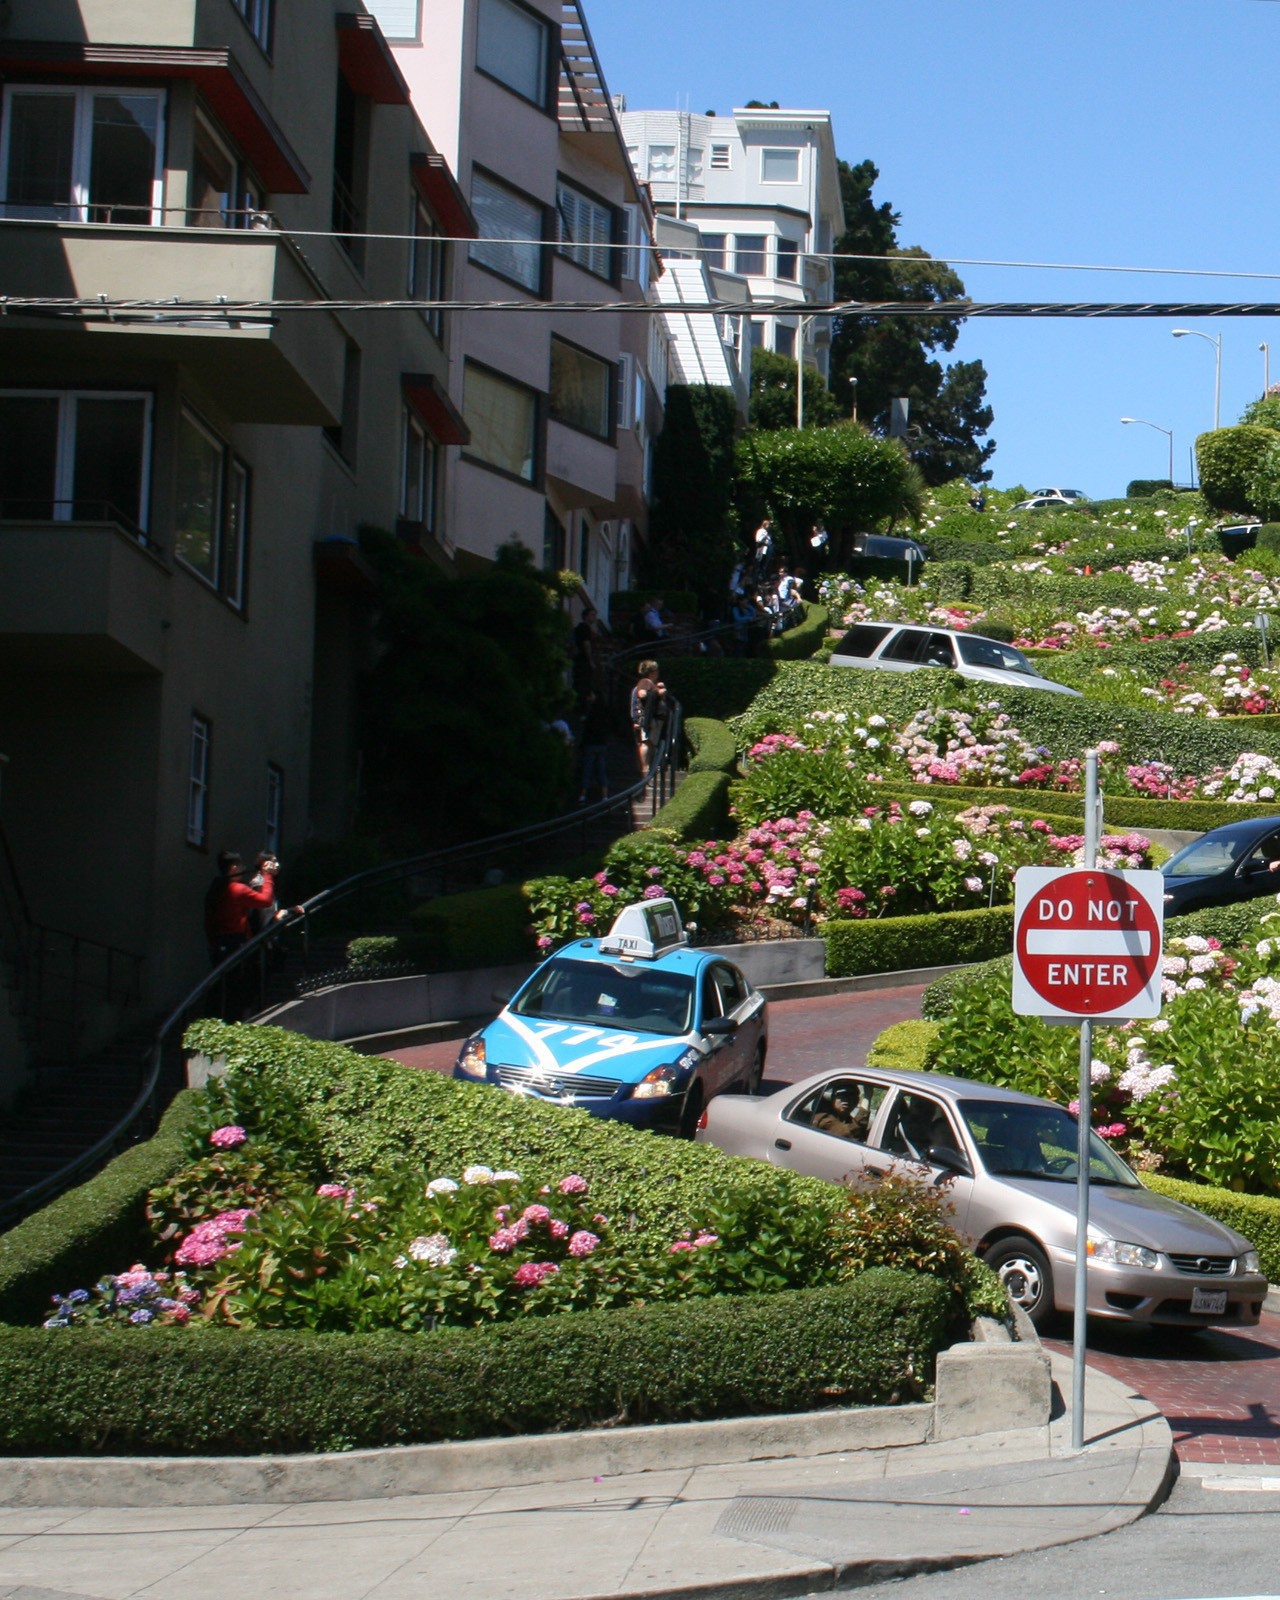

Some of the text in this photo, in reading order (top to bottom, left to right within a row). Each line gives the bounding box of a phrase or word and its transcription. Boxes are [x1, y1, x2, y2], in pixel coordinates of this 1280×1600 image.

[1039, 899, 1138, 921] DO NOT
[618, 938, 638, 950] TAXI
[1048, 964, 1128, 986] ENTER
[532, 1022, 640, 1051] 774
